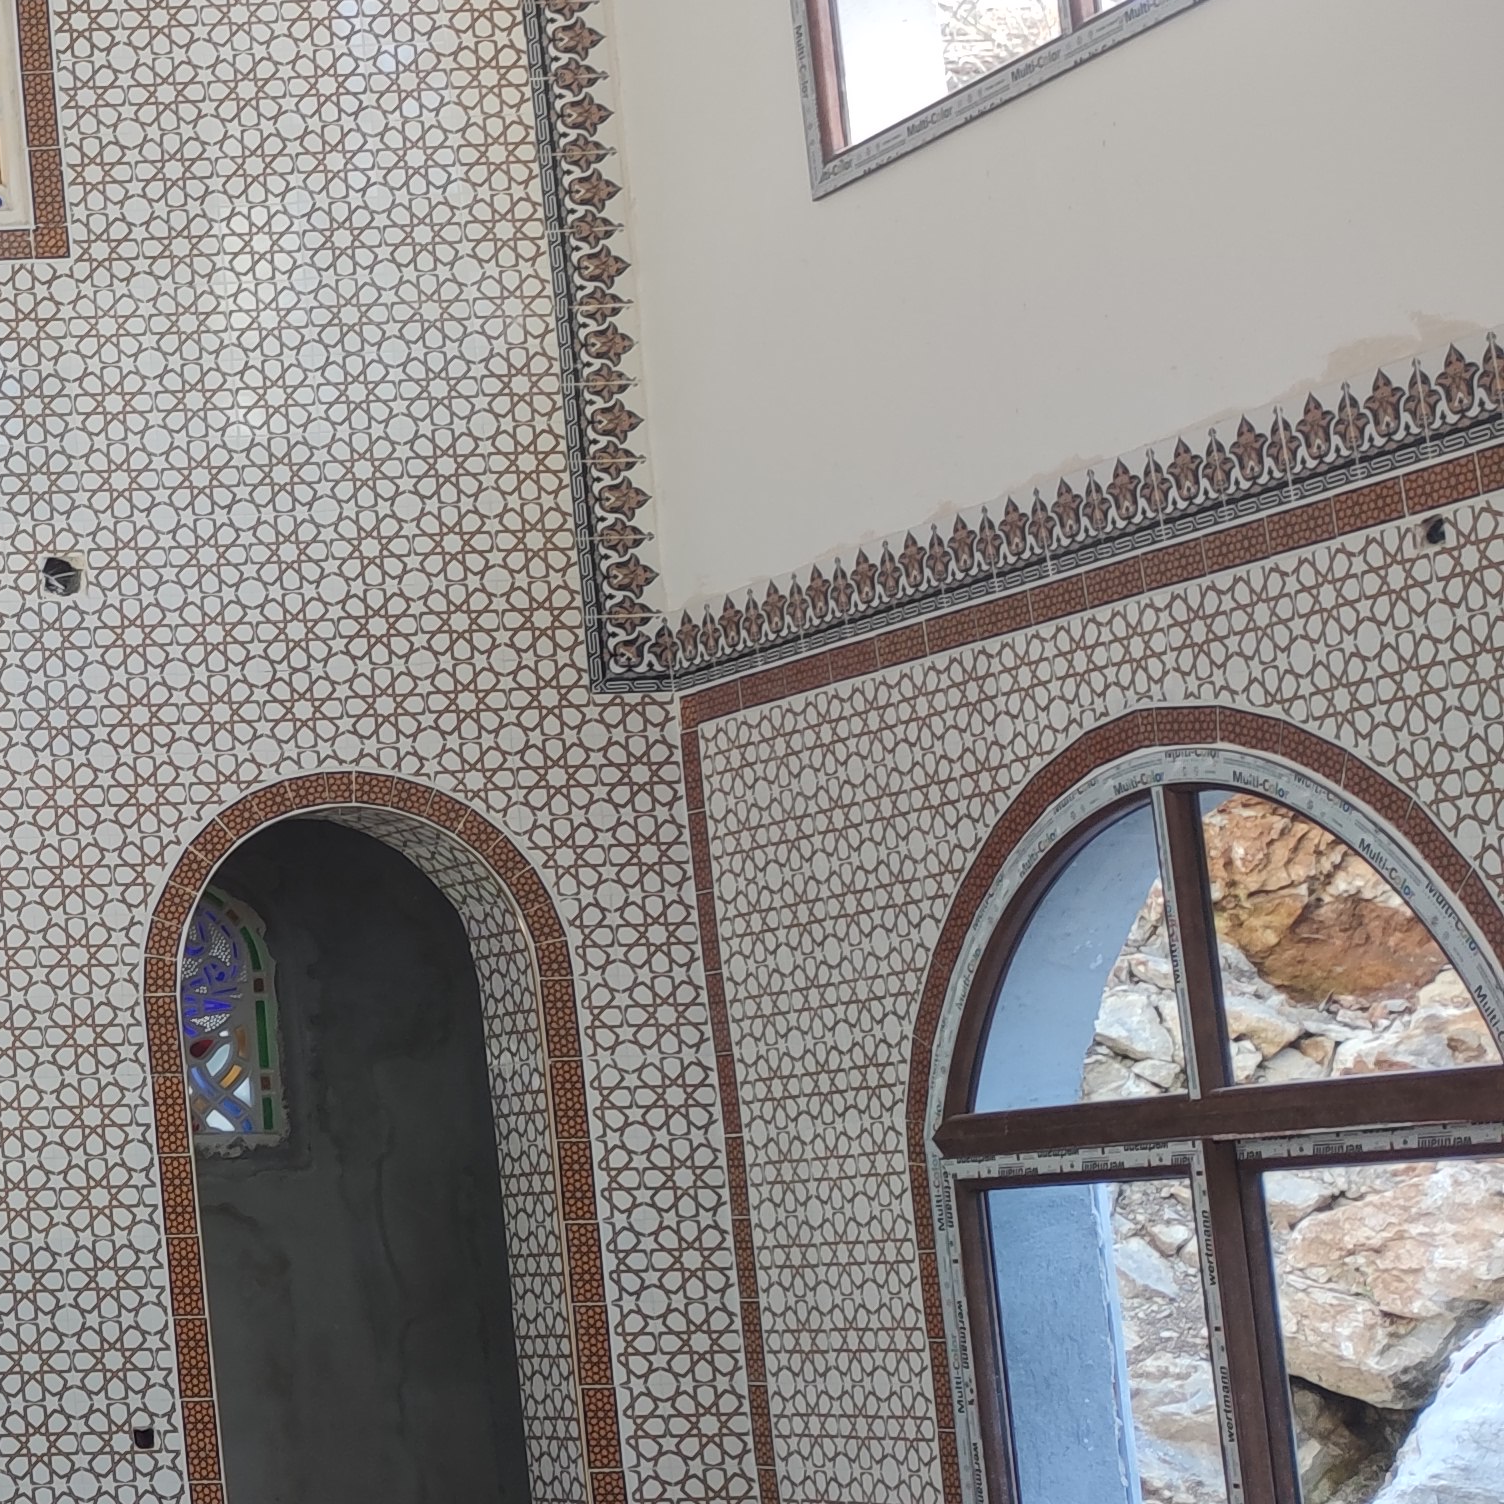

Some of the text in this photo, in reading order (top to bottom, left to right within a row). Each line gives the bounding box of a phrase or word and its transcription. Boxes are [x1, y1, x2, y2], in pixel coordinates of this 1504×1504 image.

[1010, 47, 1062, 84] Multi-Color
[906, 103, 955, 140] Multi-Color
[1231, 769, 1288, 799] Multi-Color
[1358, 836, 1416, 899] Multi-Color
[1472, 984, 1504, 1046] Multi-C
[942, 1163, 955, 1229] ertmann
[1199, 1208, 1217, 1287] wertmann
[1219, 1365, 1236, 1443] wertmann
